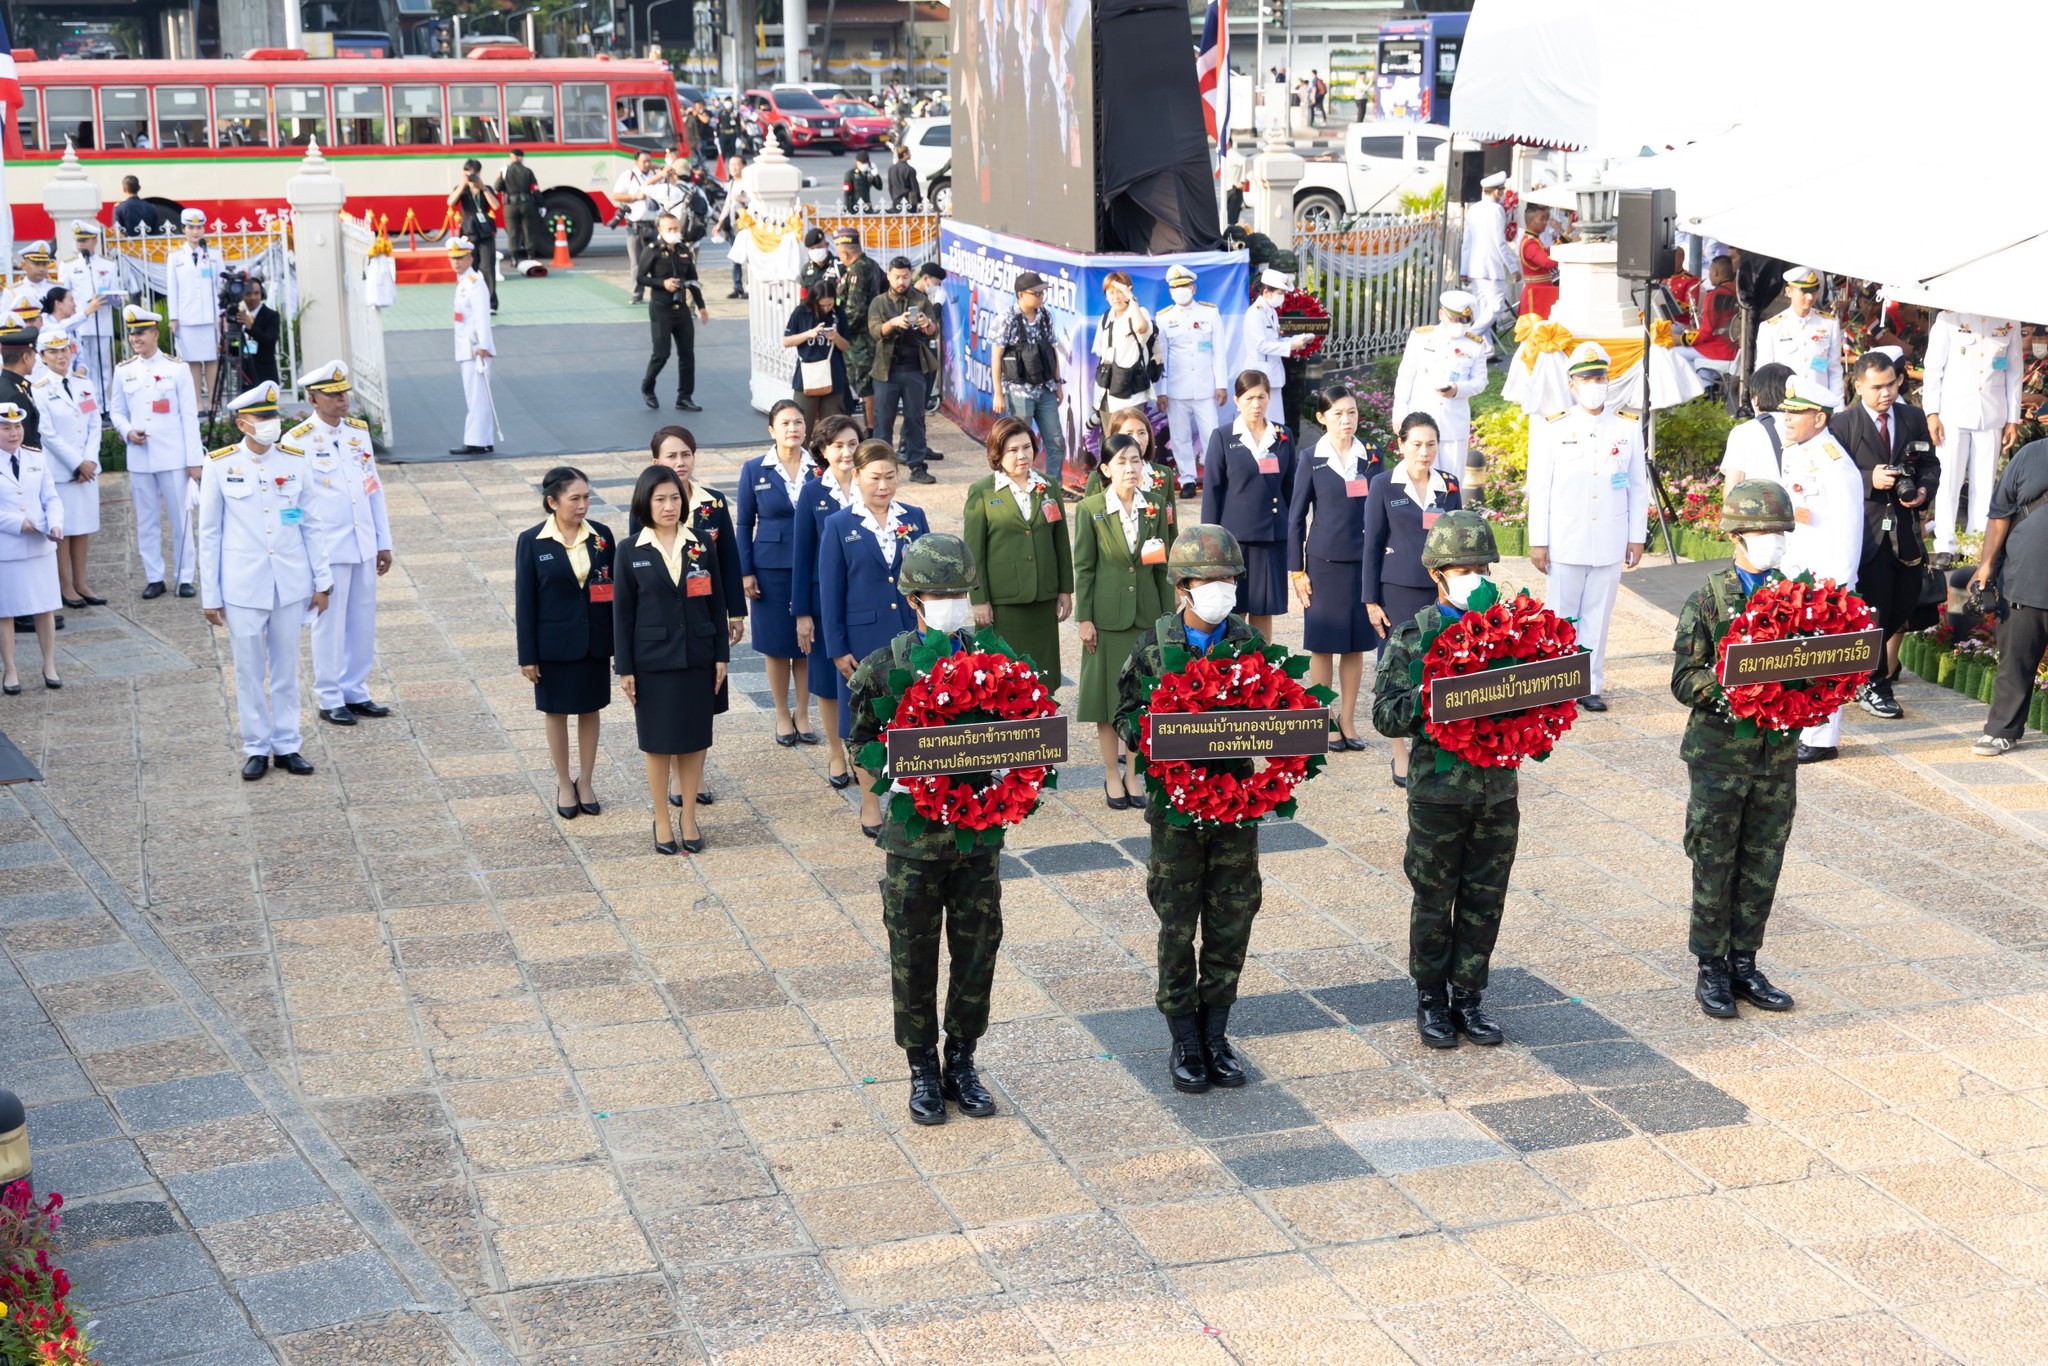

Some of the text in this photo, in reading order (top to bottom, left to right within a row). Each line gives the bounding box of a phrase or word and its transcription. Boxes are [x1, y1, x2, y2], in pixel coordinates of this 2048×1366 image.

[1738, 639, 1871, 673] สมาคมภริยาทหารเรือ
[1445, 670, 1581, 708] สมาคมแม่บ้านทหารบก
[918, 726, 1040, 748] สมาคมภริยาข้าราชการ
[1158, 715, 1323, 736] สมาคมแม่บ้านกองบัญชาการ
[1208, 735, 1274, 752] กองทัพไทย
[895, 743, 1062, 772] สำนักงานปลัดกระทรวงกลาโหม
